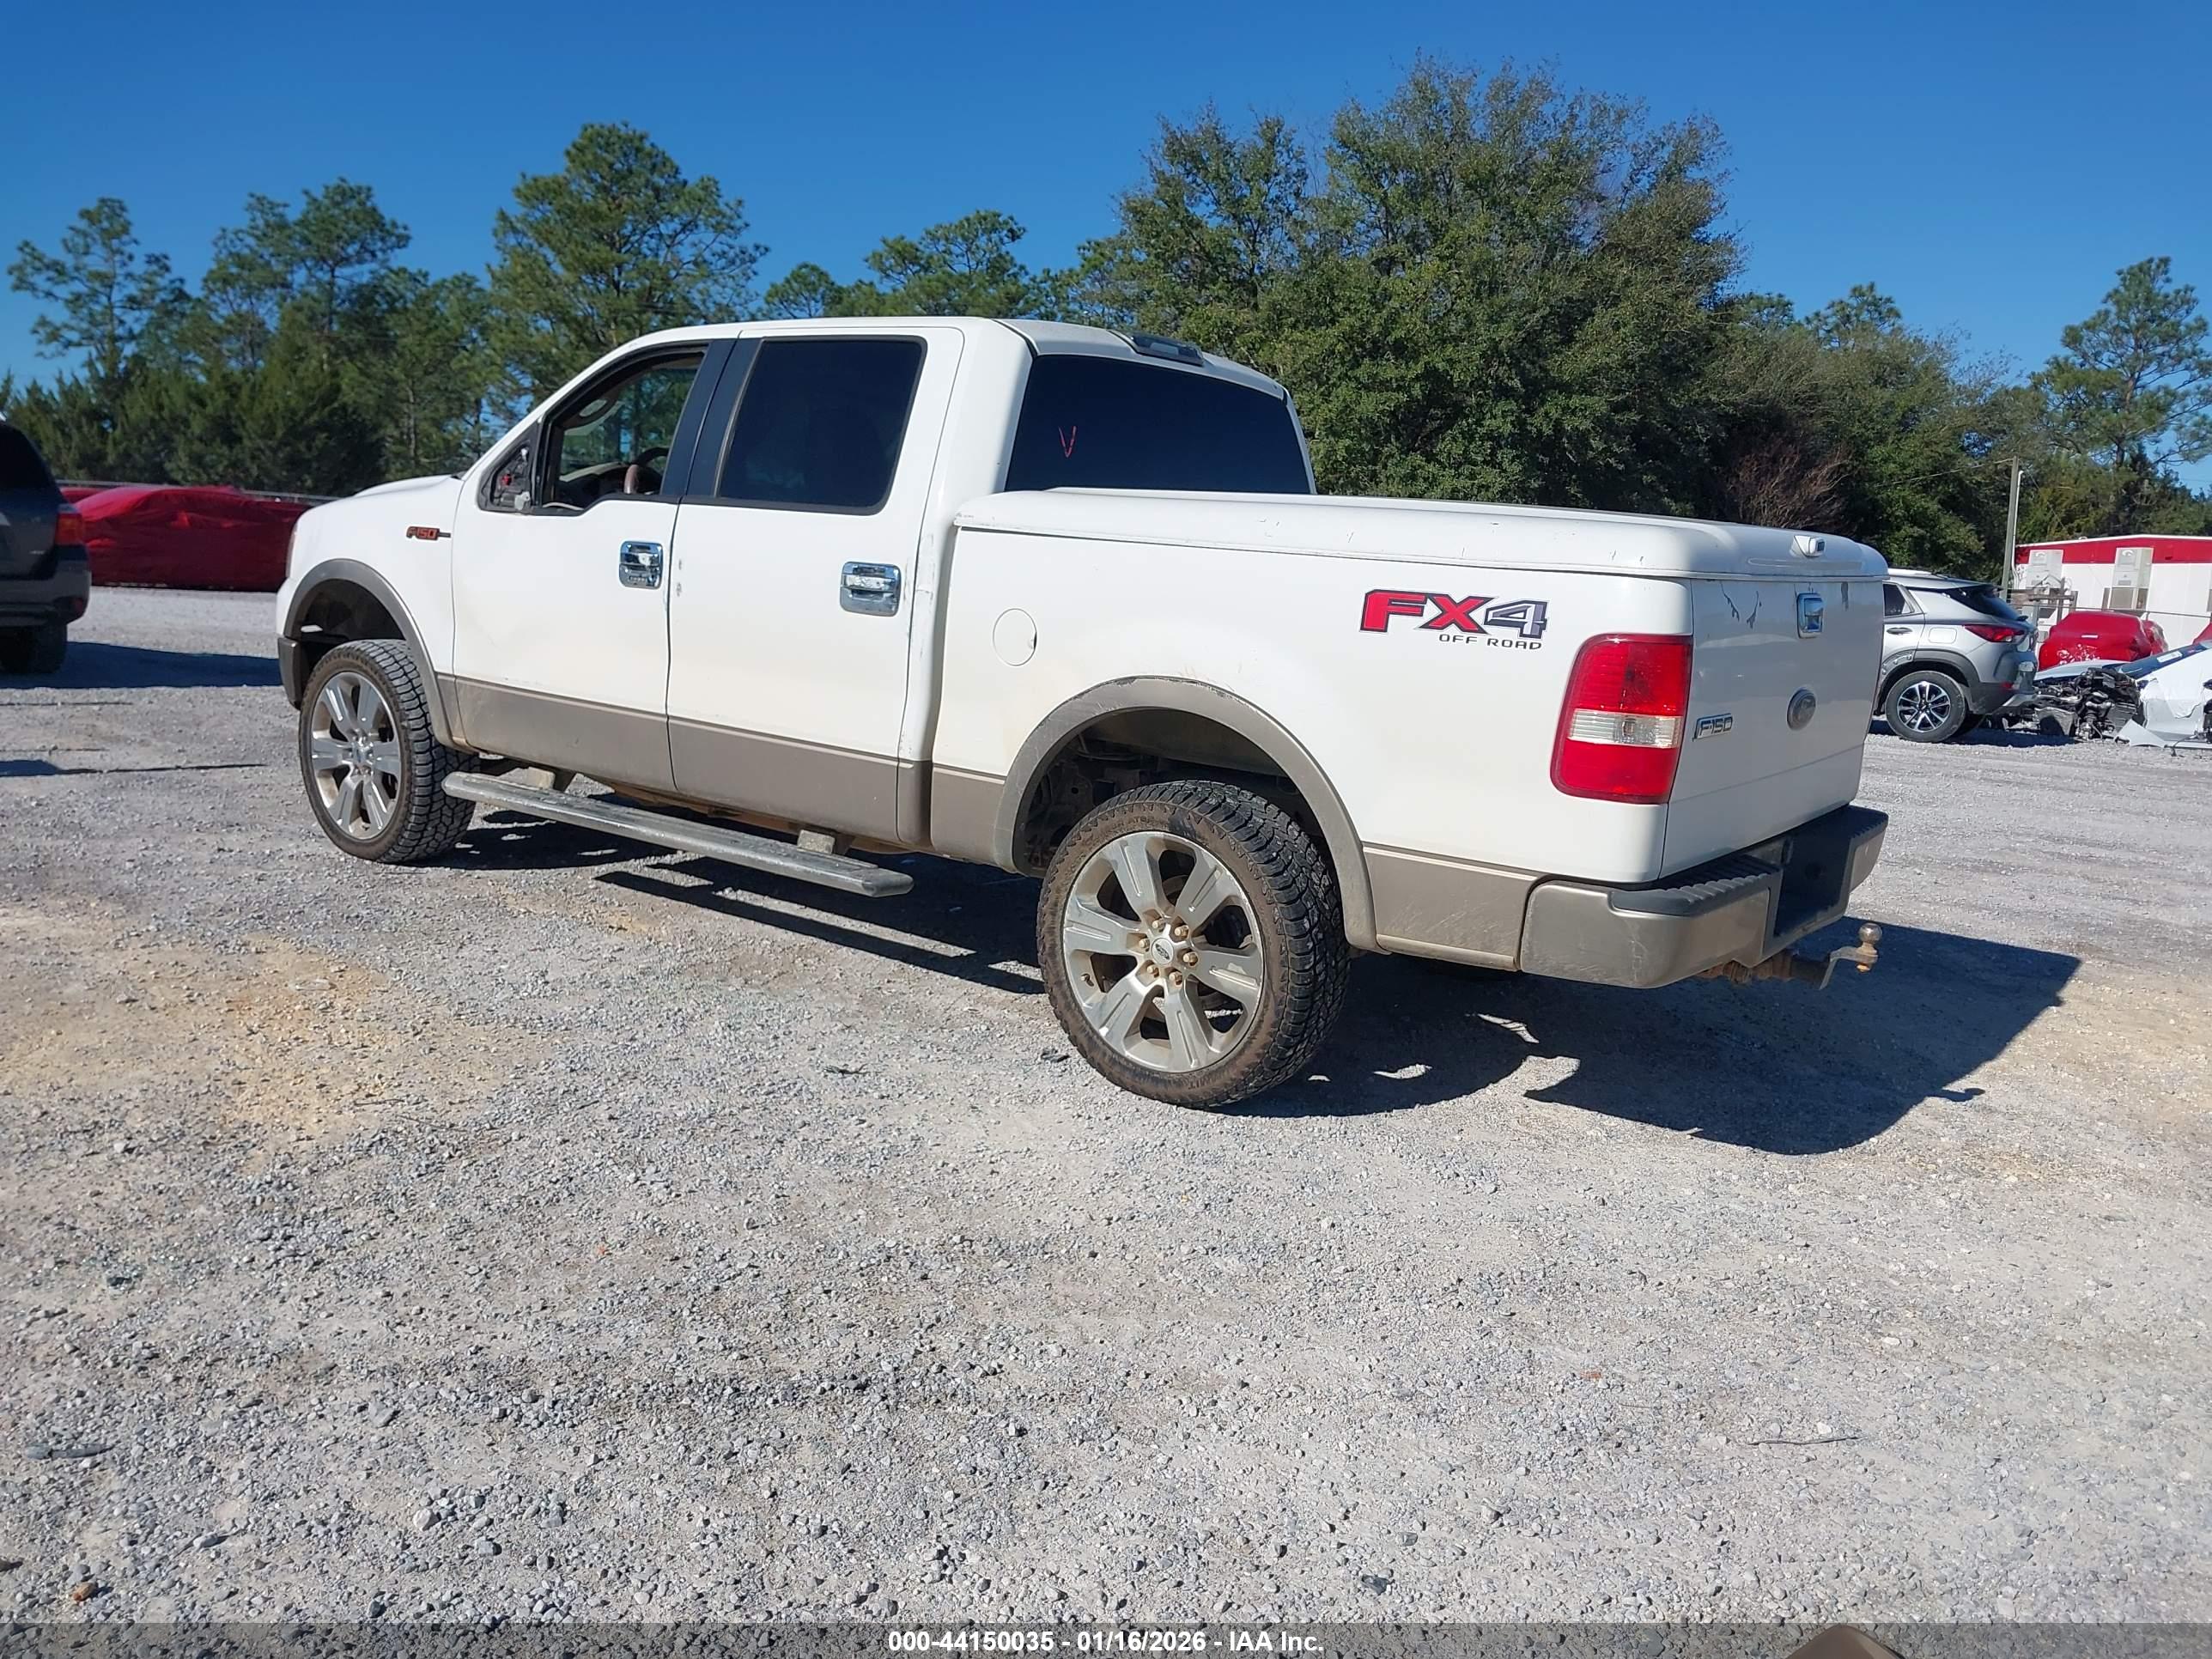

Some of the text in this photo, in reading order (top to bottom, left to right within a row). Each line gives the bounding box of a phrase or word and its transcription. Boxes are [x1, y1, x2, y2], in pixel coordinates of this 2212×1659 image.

[1360, 589, 1548, 640] FX4
[1438, 634, 1543, 650] OFF ROAD
